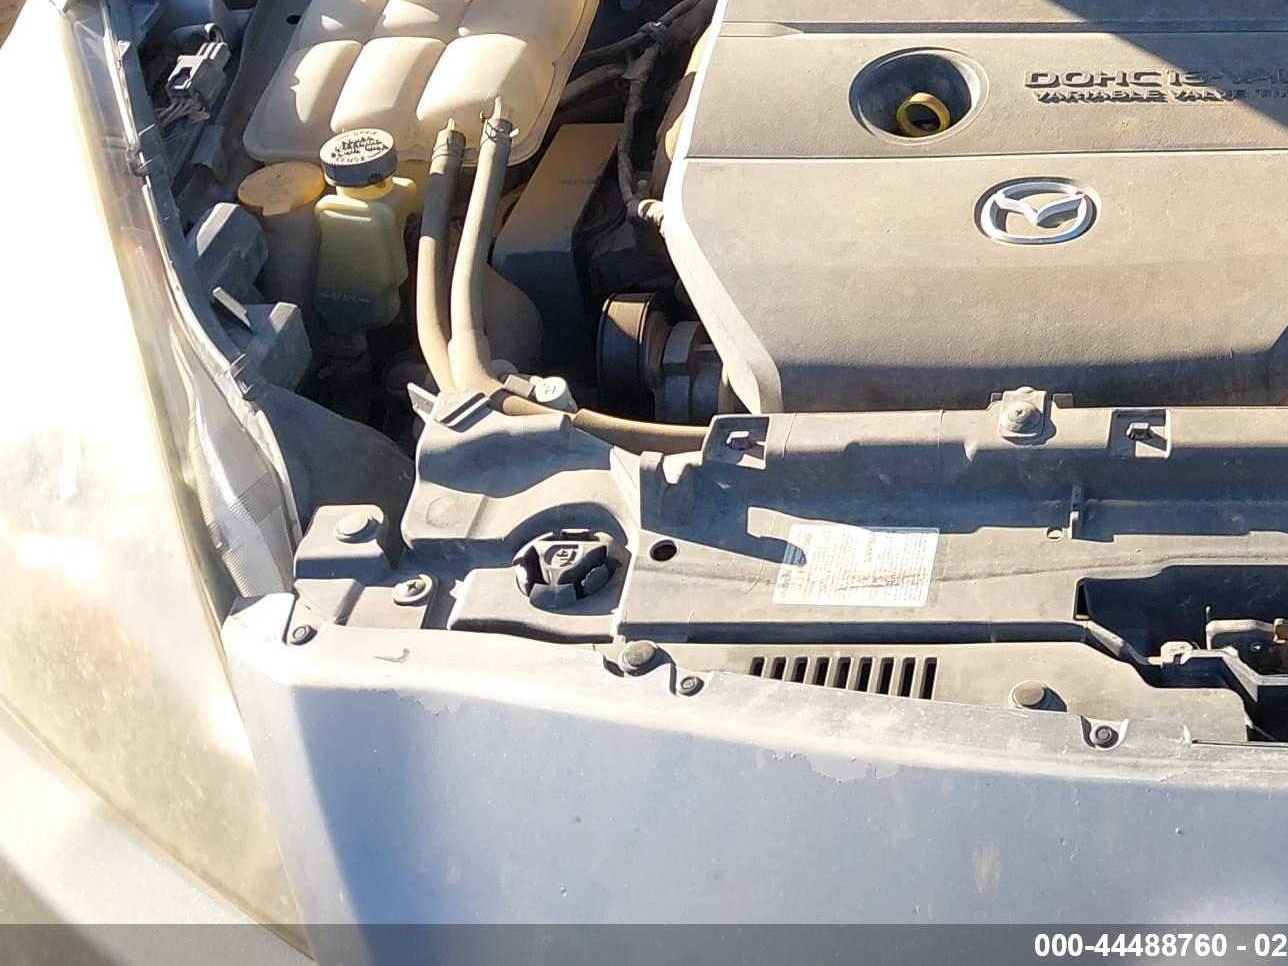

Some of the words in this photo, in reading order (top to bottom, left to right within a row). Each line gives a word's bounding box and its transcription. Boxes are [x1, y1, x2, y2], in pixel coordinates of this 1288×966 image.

[1023, 70, 1163, 88] DOHC
[1033, 89, 1168, 104] VARIABLE
[1167, 88, 1249, 103] VALVE
